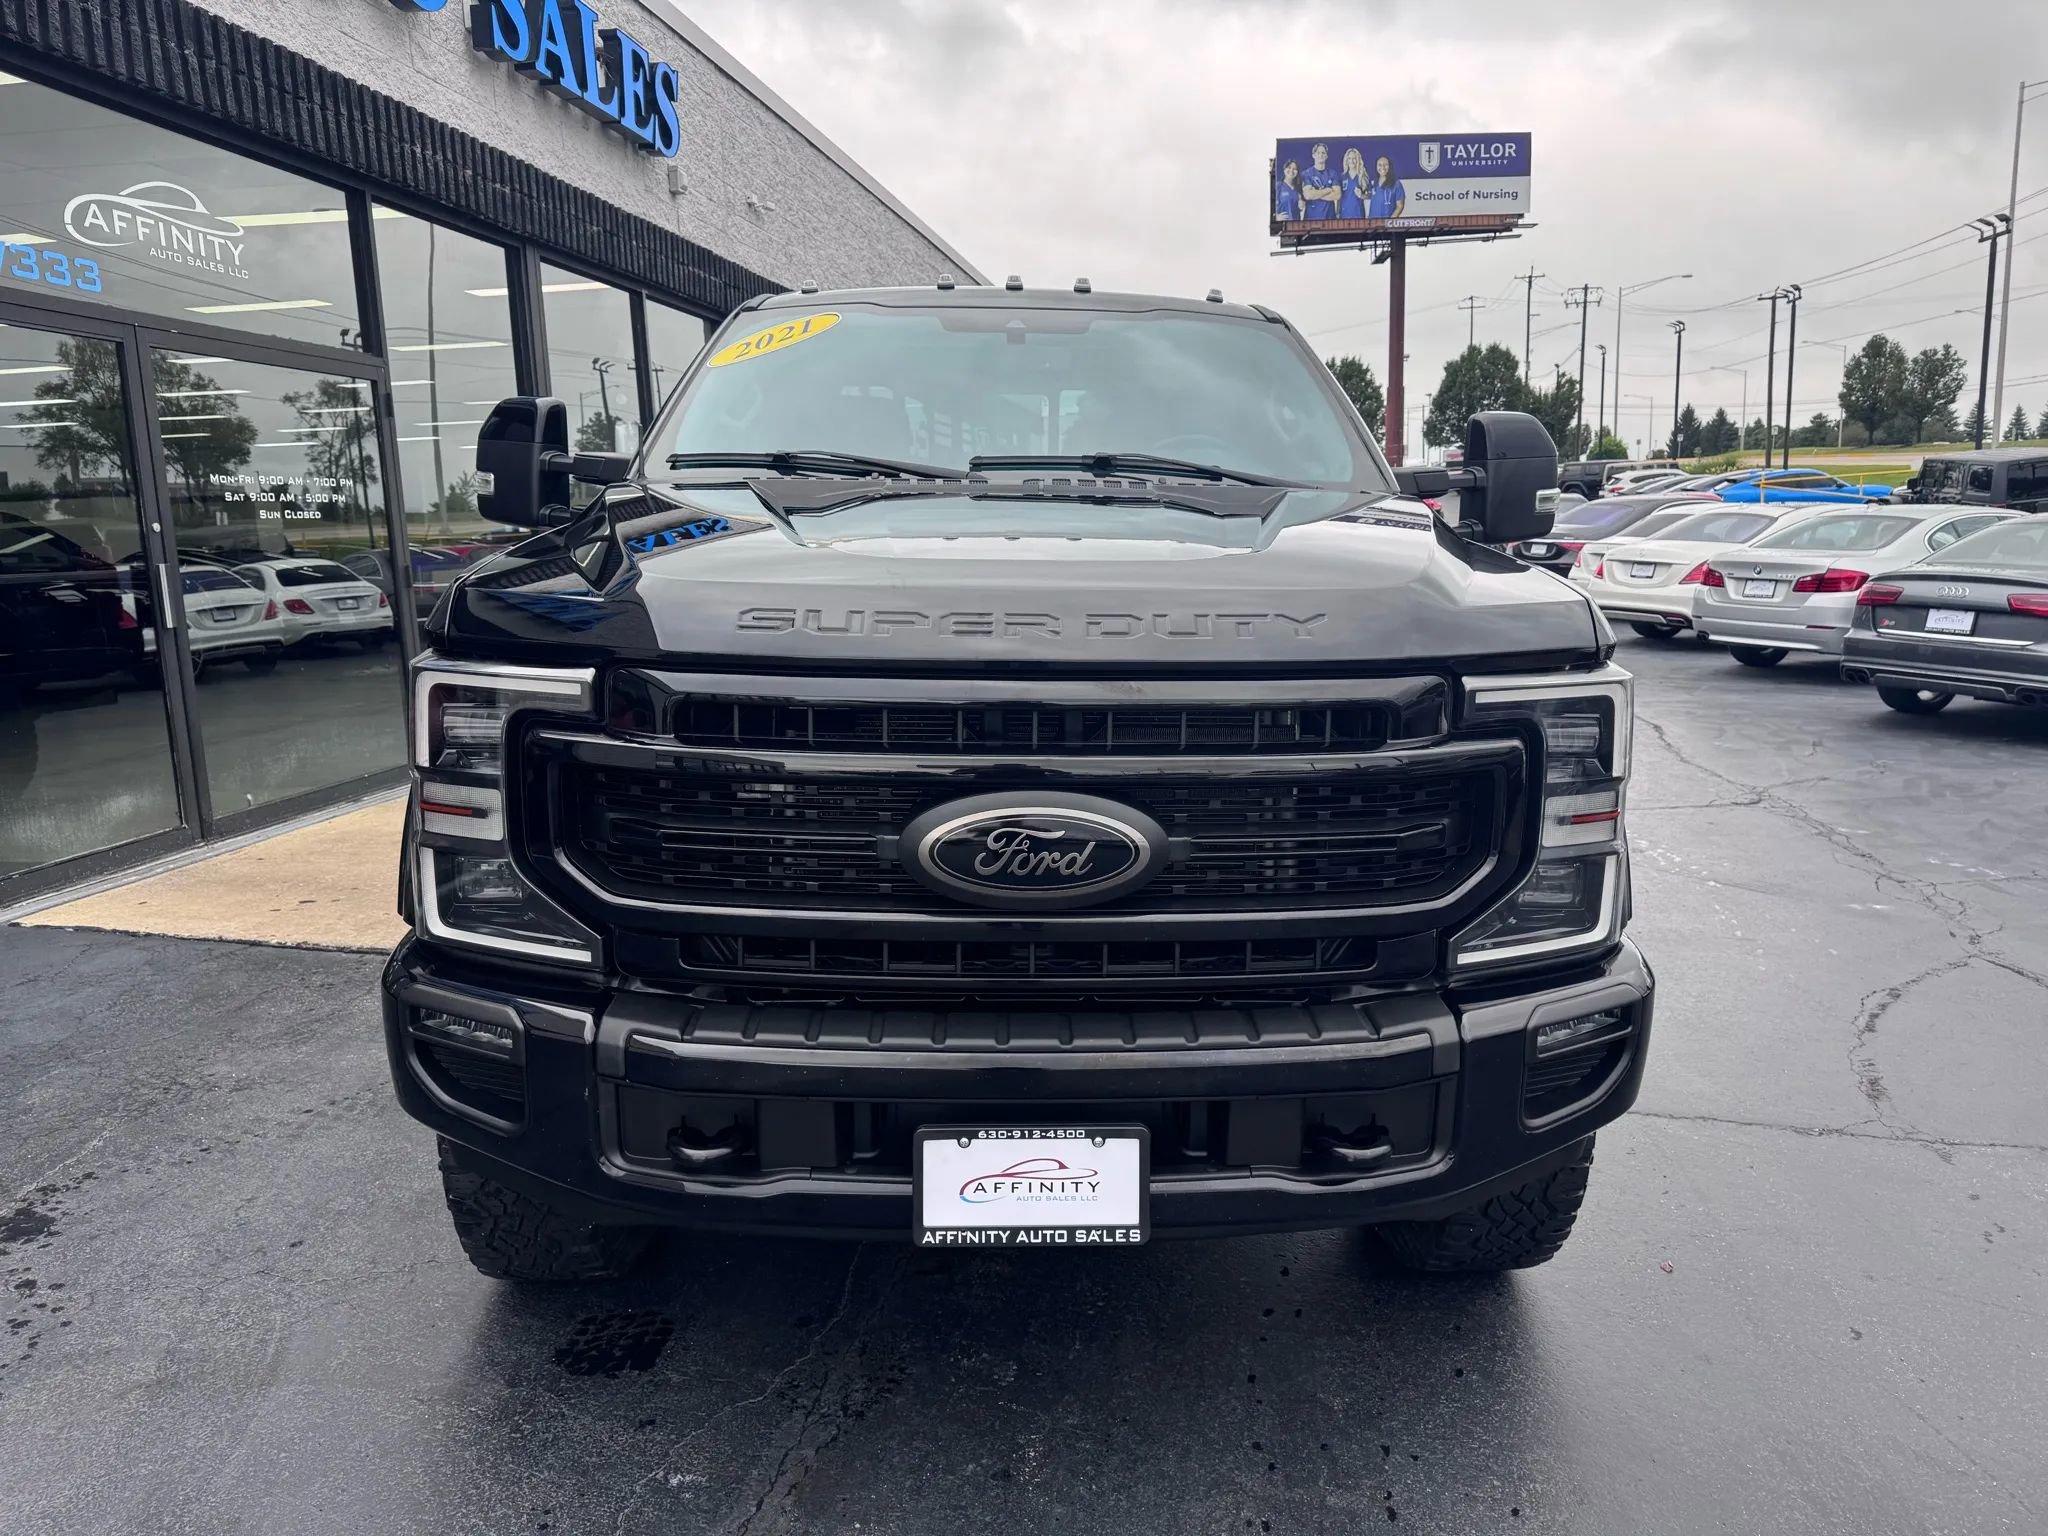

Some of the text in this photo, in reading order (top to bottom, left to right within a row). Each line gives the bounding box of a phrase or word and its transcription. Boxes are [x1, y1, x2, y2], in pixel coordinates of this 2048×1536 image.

[490, 0, 681, 158] SALES
[1444, 143, 1516, 159] TAYLOR
[1415, 189, 1519, 201] School of Nursing
[84, 203, 245, 266] AFFINITY
[149, 247, 249, 279] AUTO SALES LLC
[734, 319, 813, 360] 2021
[259, 475, 284, 485] 9:00
[287, 476, 303, 486] AM
[313, 477, 336, 487] 7:00
[340, 478, 354, 488] PM
[224, 491, 245, 502] SAT
[249, 492, 275, 502] 9:00
[279, 493, 295, 502] AM
[305, 494, 328, 503] 5:00
[332, 494, 346, 503] PM
[259, 509, 321, 519] SUN CLOSED
[736, 608, 1328, 640] SUPER DUTY
[974, 827, 1097, 876] Ford
[978, 1130, 1085, 1139] 630-912-4500
[973, 1181, 1101, 1194] AFFINITY
[922, 1229, 1141, 1244] AFFINITY AUTO SALES
